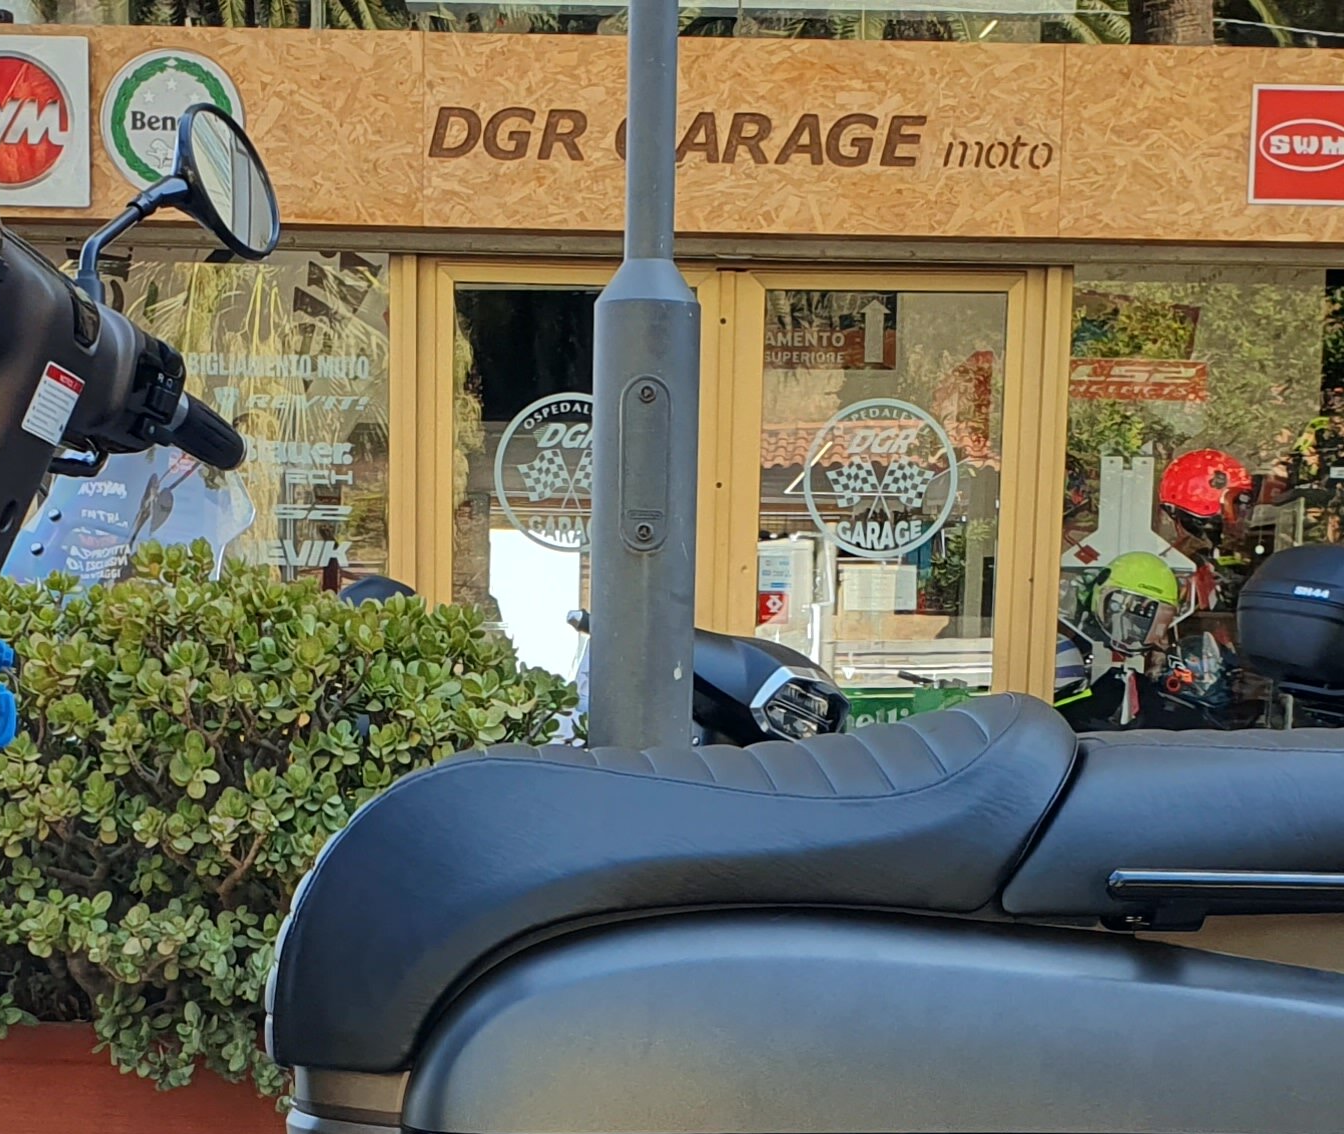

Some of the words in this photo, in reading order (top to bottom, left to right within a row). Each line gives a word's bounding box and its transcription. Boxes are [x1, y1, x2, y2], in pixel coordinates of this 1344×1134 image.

[130, 110, 180, 132] Ben
[428, 106, 587, 161] DGR
[615, 110, 927, 168] ARAGE
[943, 134, 1054, 170] moto
[184, 352, 312, 378] BIGLIAMENTO
[523, 402, 593, 430] OSPEDAL
[528, 515, 593, 546] GARA
[837, 520, 923, 549] GARAGE
